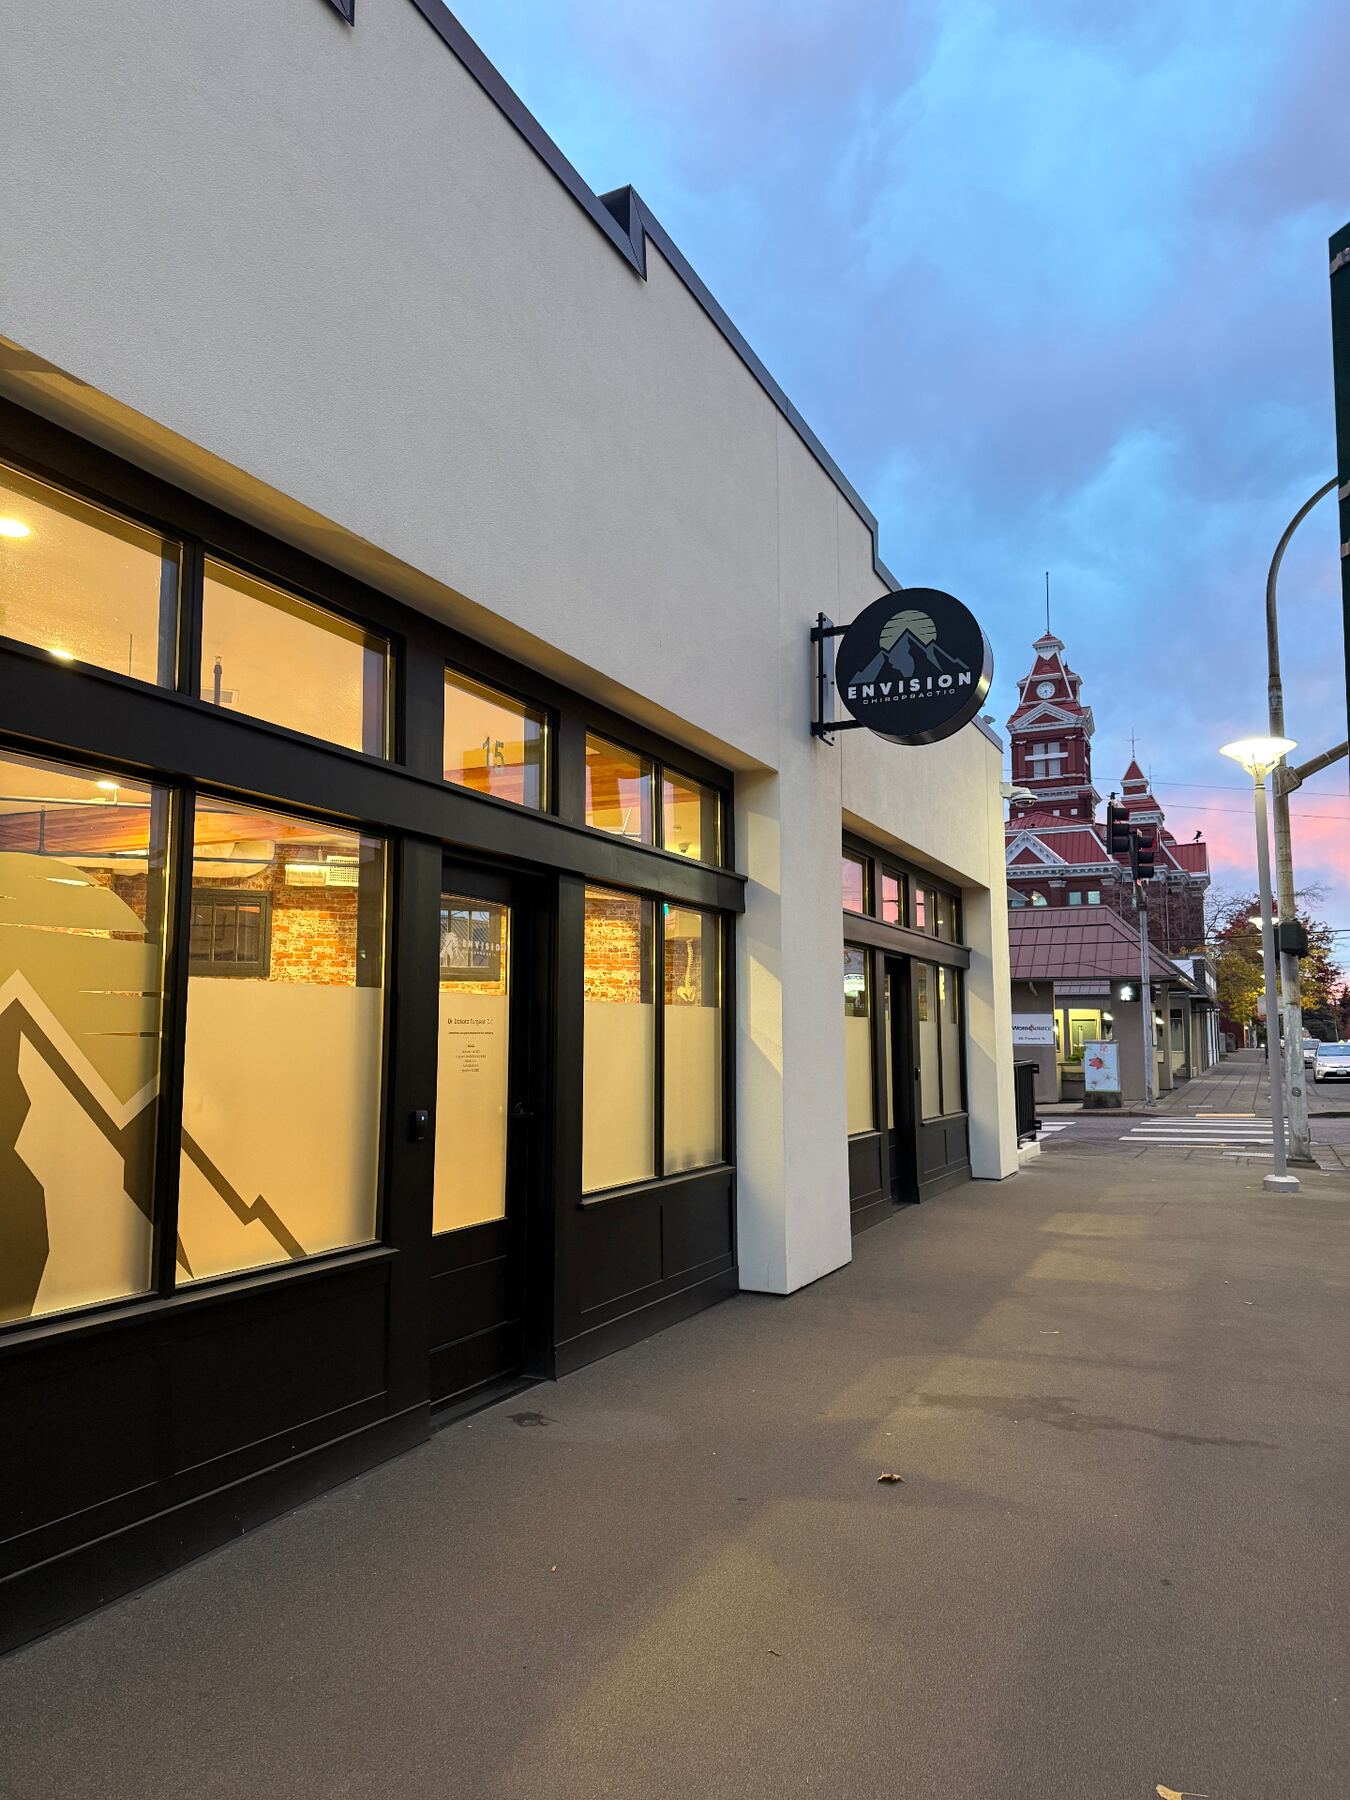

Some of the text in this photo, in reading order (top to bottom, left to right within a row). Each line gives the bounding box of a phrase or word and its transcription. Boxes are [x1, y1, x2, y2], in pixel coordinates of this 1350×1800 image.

[848, 672, 971, 699] ENVISION
[863, 688, 955, 705] CHIROPRACTIC
[483, 736, 504, 775] 15
